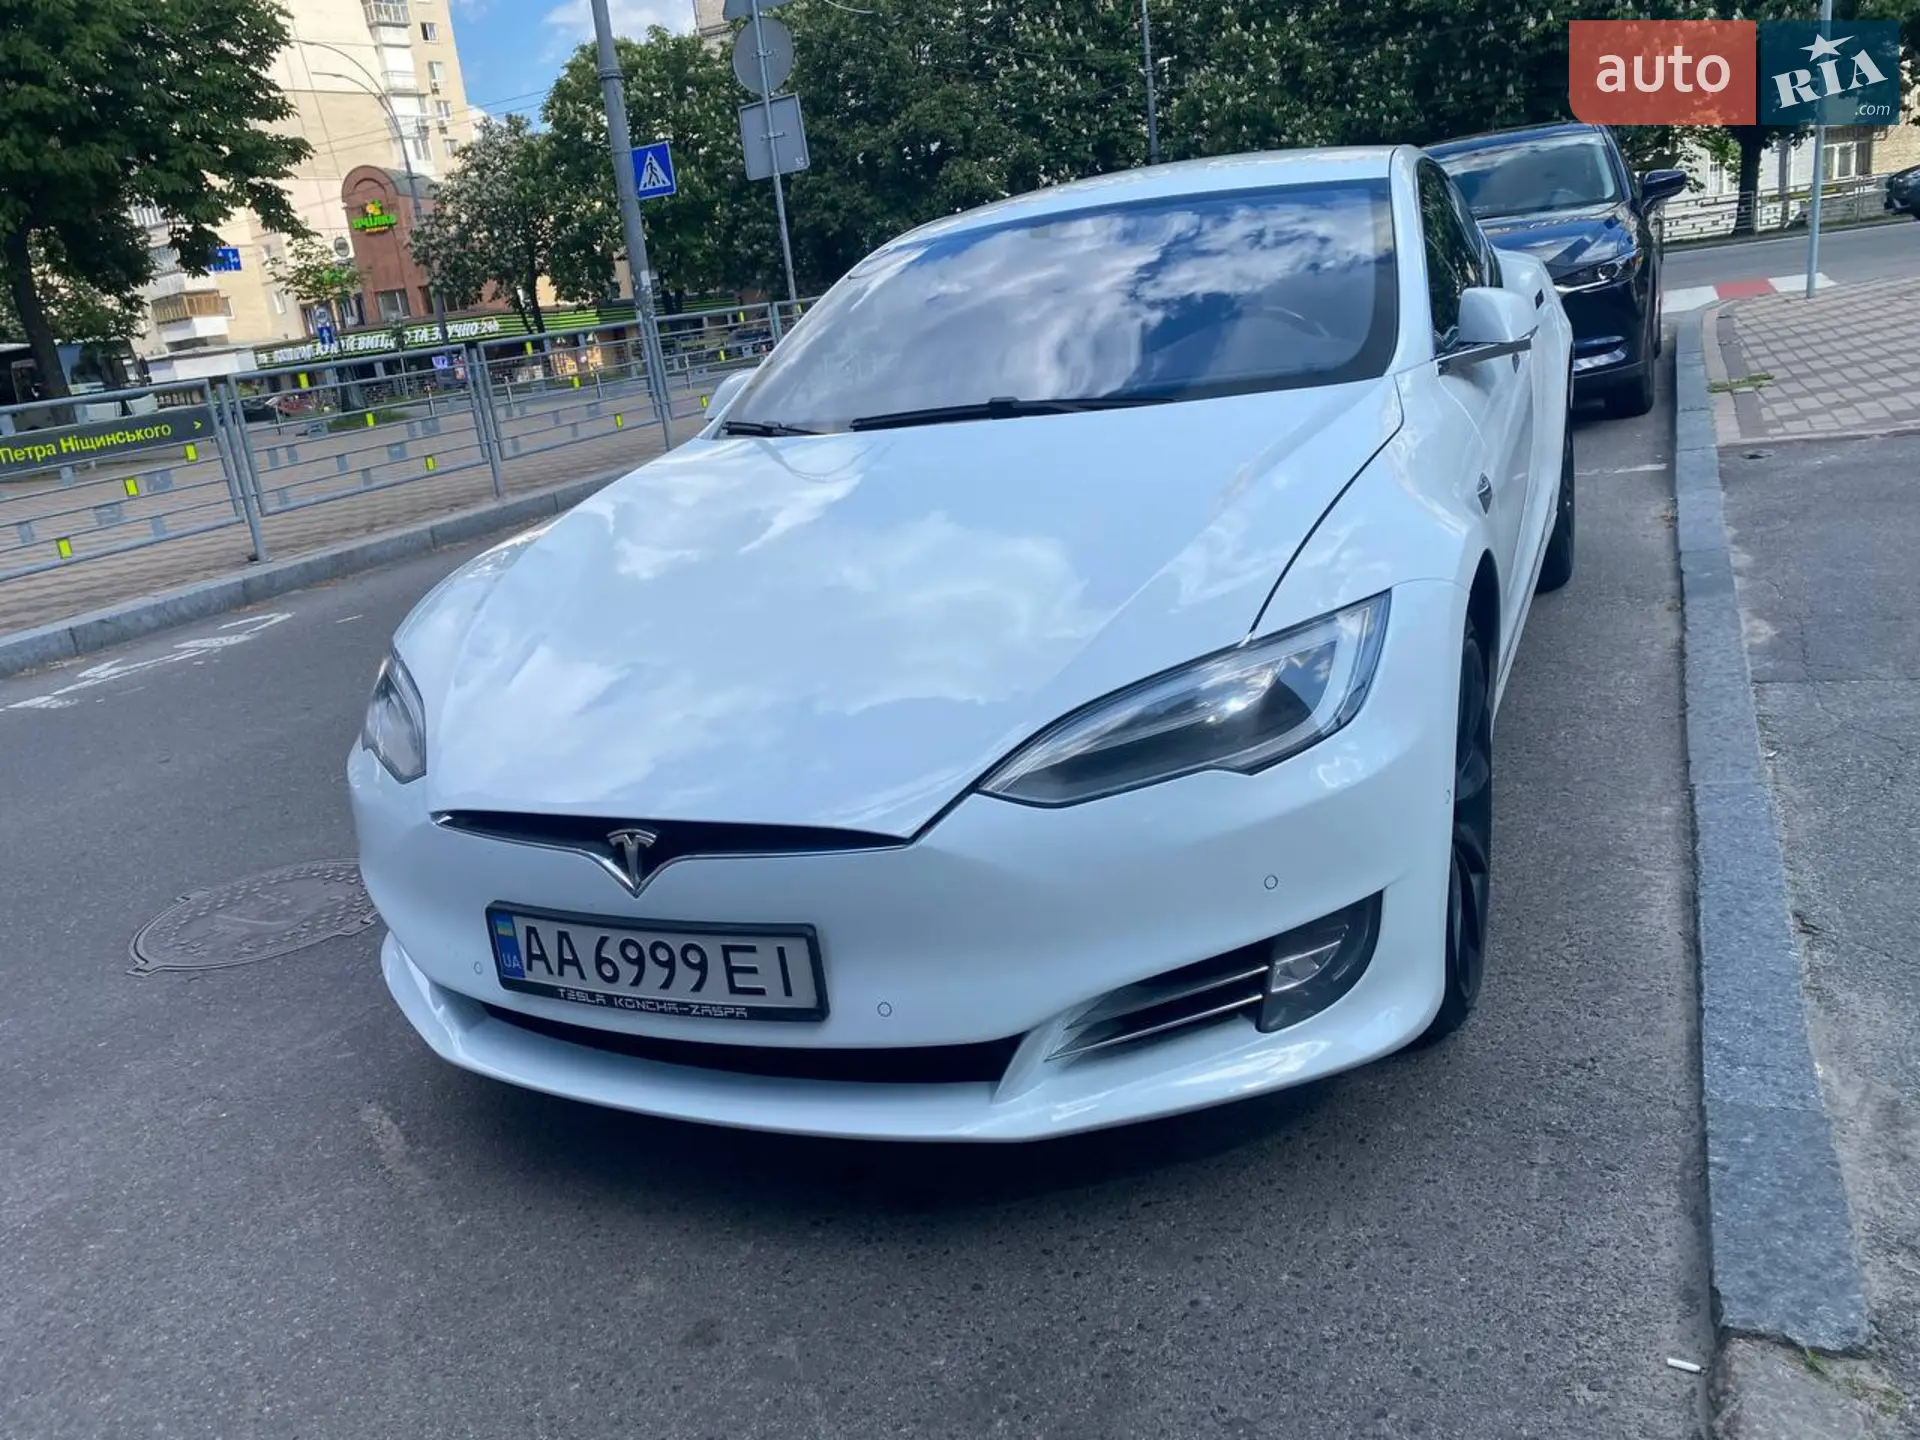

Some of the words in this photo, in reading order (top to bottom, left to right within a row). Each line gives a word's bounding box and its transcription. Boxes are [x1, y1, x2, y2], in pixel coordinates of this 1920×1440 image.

[0, 441, 57, 464] Петра
[60, 423, 172, 453] Ніщинського
[502, 953, 525, 970] UA
[558, 988, 606, 1005] TESLA
